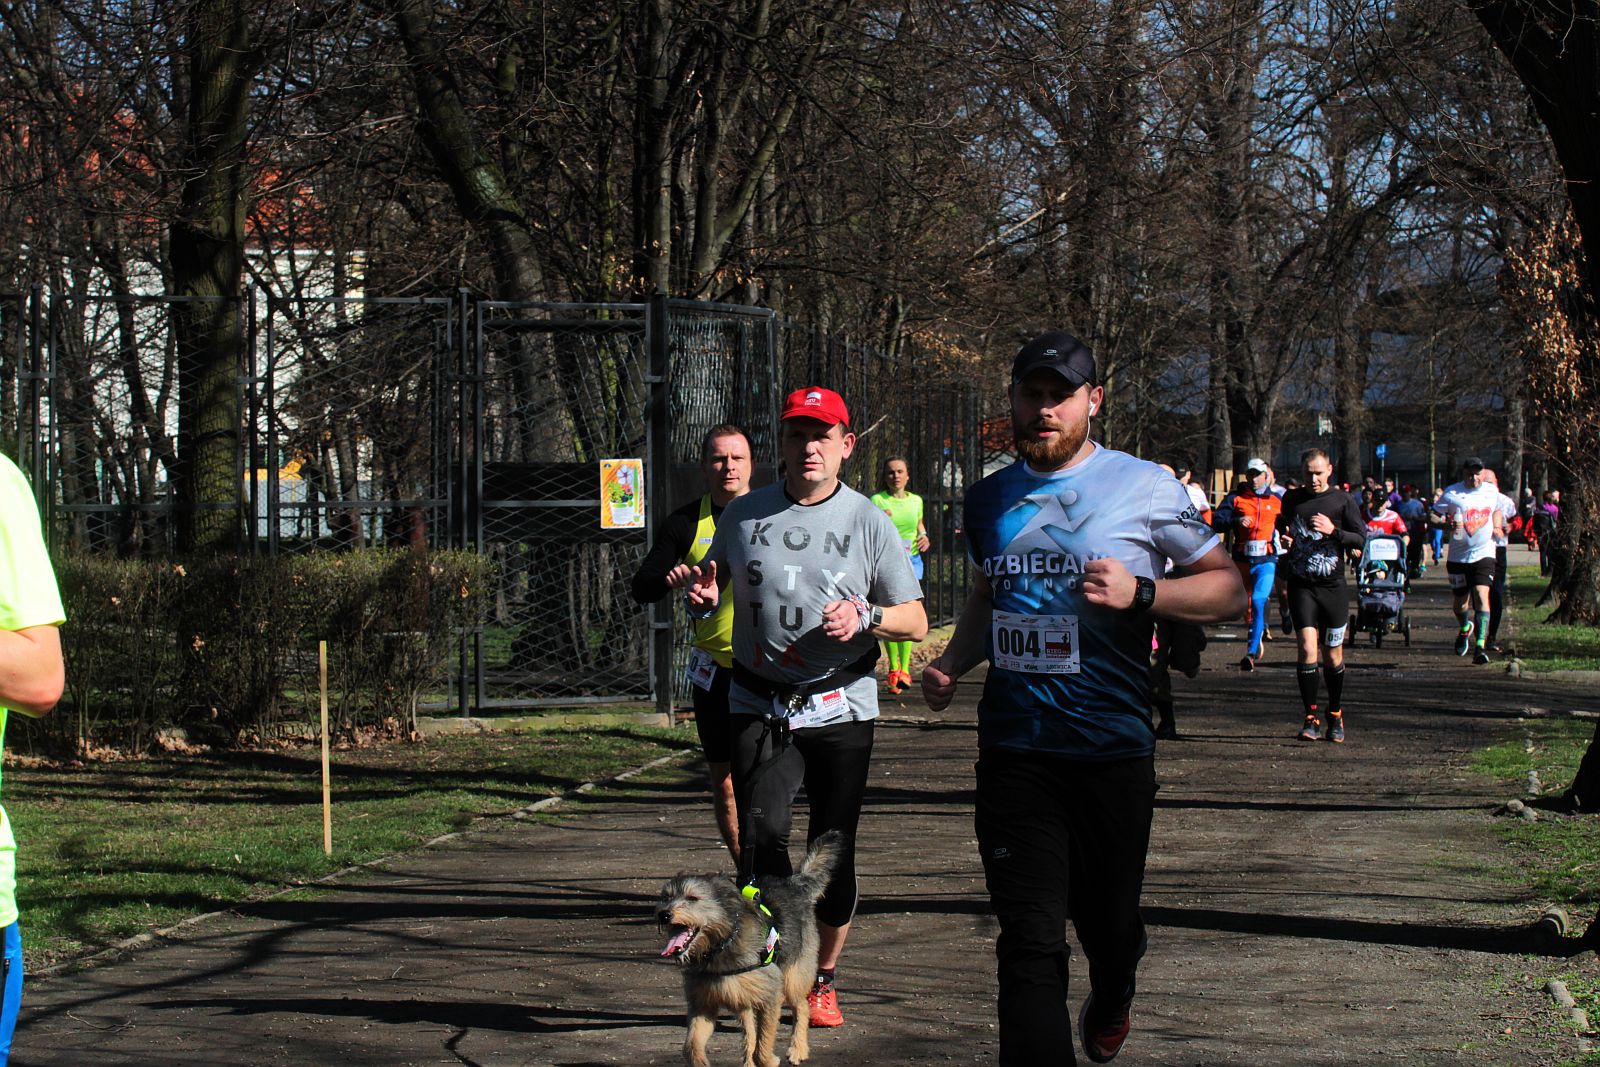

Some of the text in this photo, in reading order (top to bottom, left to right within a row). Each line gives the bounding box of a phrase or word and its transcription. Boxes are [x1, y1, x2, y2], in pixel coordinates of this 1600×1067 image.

[750, 522, 851, 558] KON
[747, 560, 847, 596] STY
[983, 553, 1099, 577] OZBIEGAN
[998, 627, 1041, 658] 004
